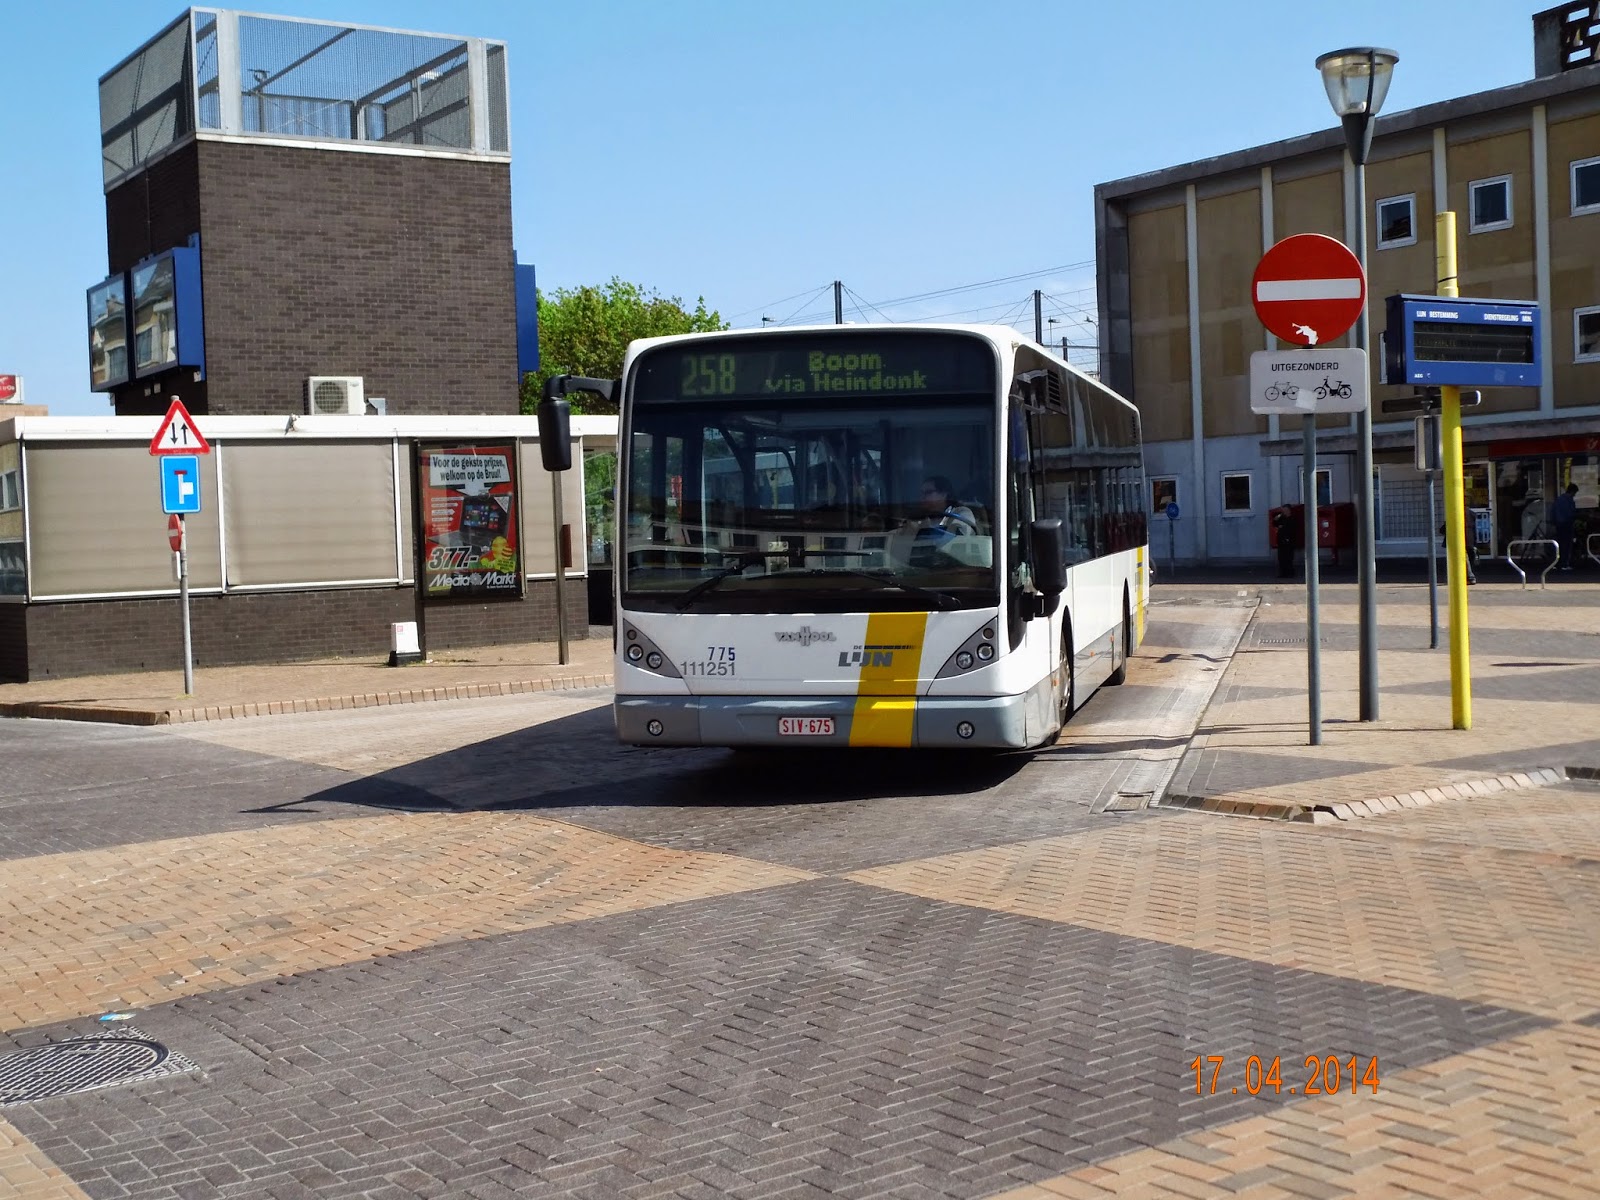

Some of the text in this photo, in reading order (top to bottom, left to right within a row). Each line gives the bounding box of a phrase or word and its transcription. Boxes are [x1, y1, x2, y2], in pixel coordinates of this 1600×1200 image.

[1429, 311, 1458, 319] BESTEMMING
[809, 351, 882, 371] Boom
[1271, 362, 1339, 372] UITGEZONDERD
[681, 352, 736, 395] 258
[765, 370, 928, 392] via Heindonk
[432, 456, 506, 470] Voor de gekste prijzen,
[440, 470, 466, 481] welkom
[467, 472, 475, 482] op
[476, 470, 484, 479] de
[429, 571, 516, 587] Media Markt
[708, 647, 735, 661] 775
[680, 662, 735, 676] 111251
